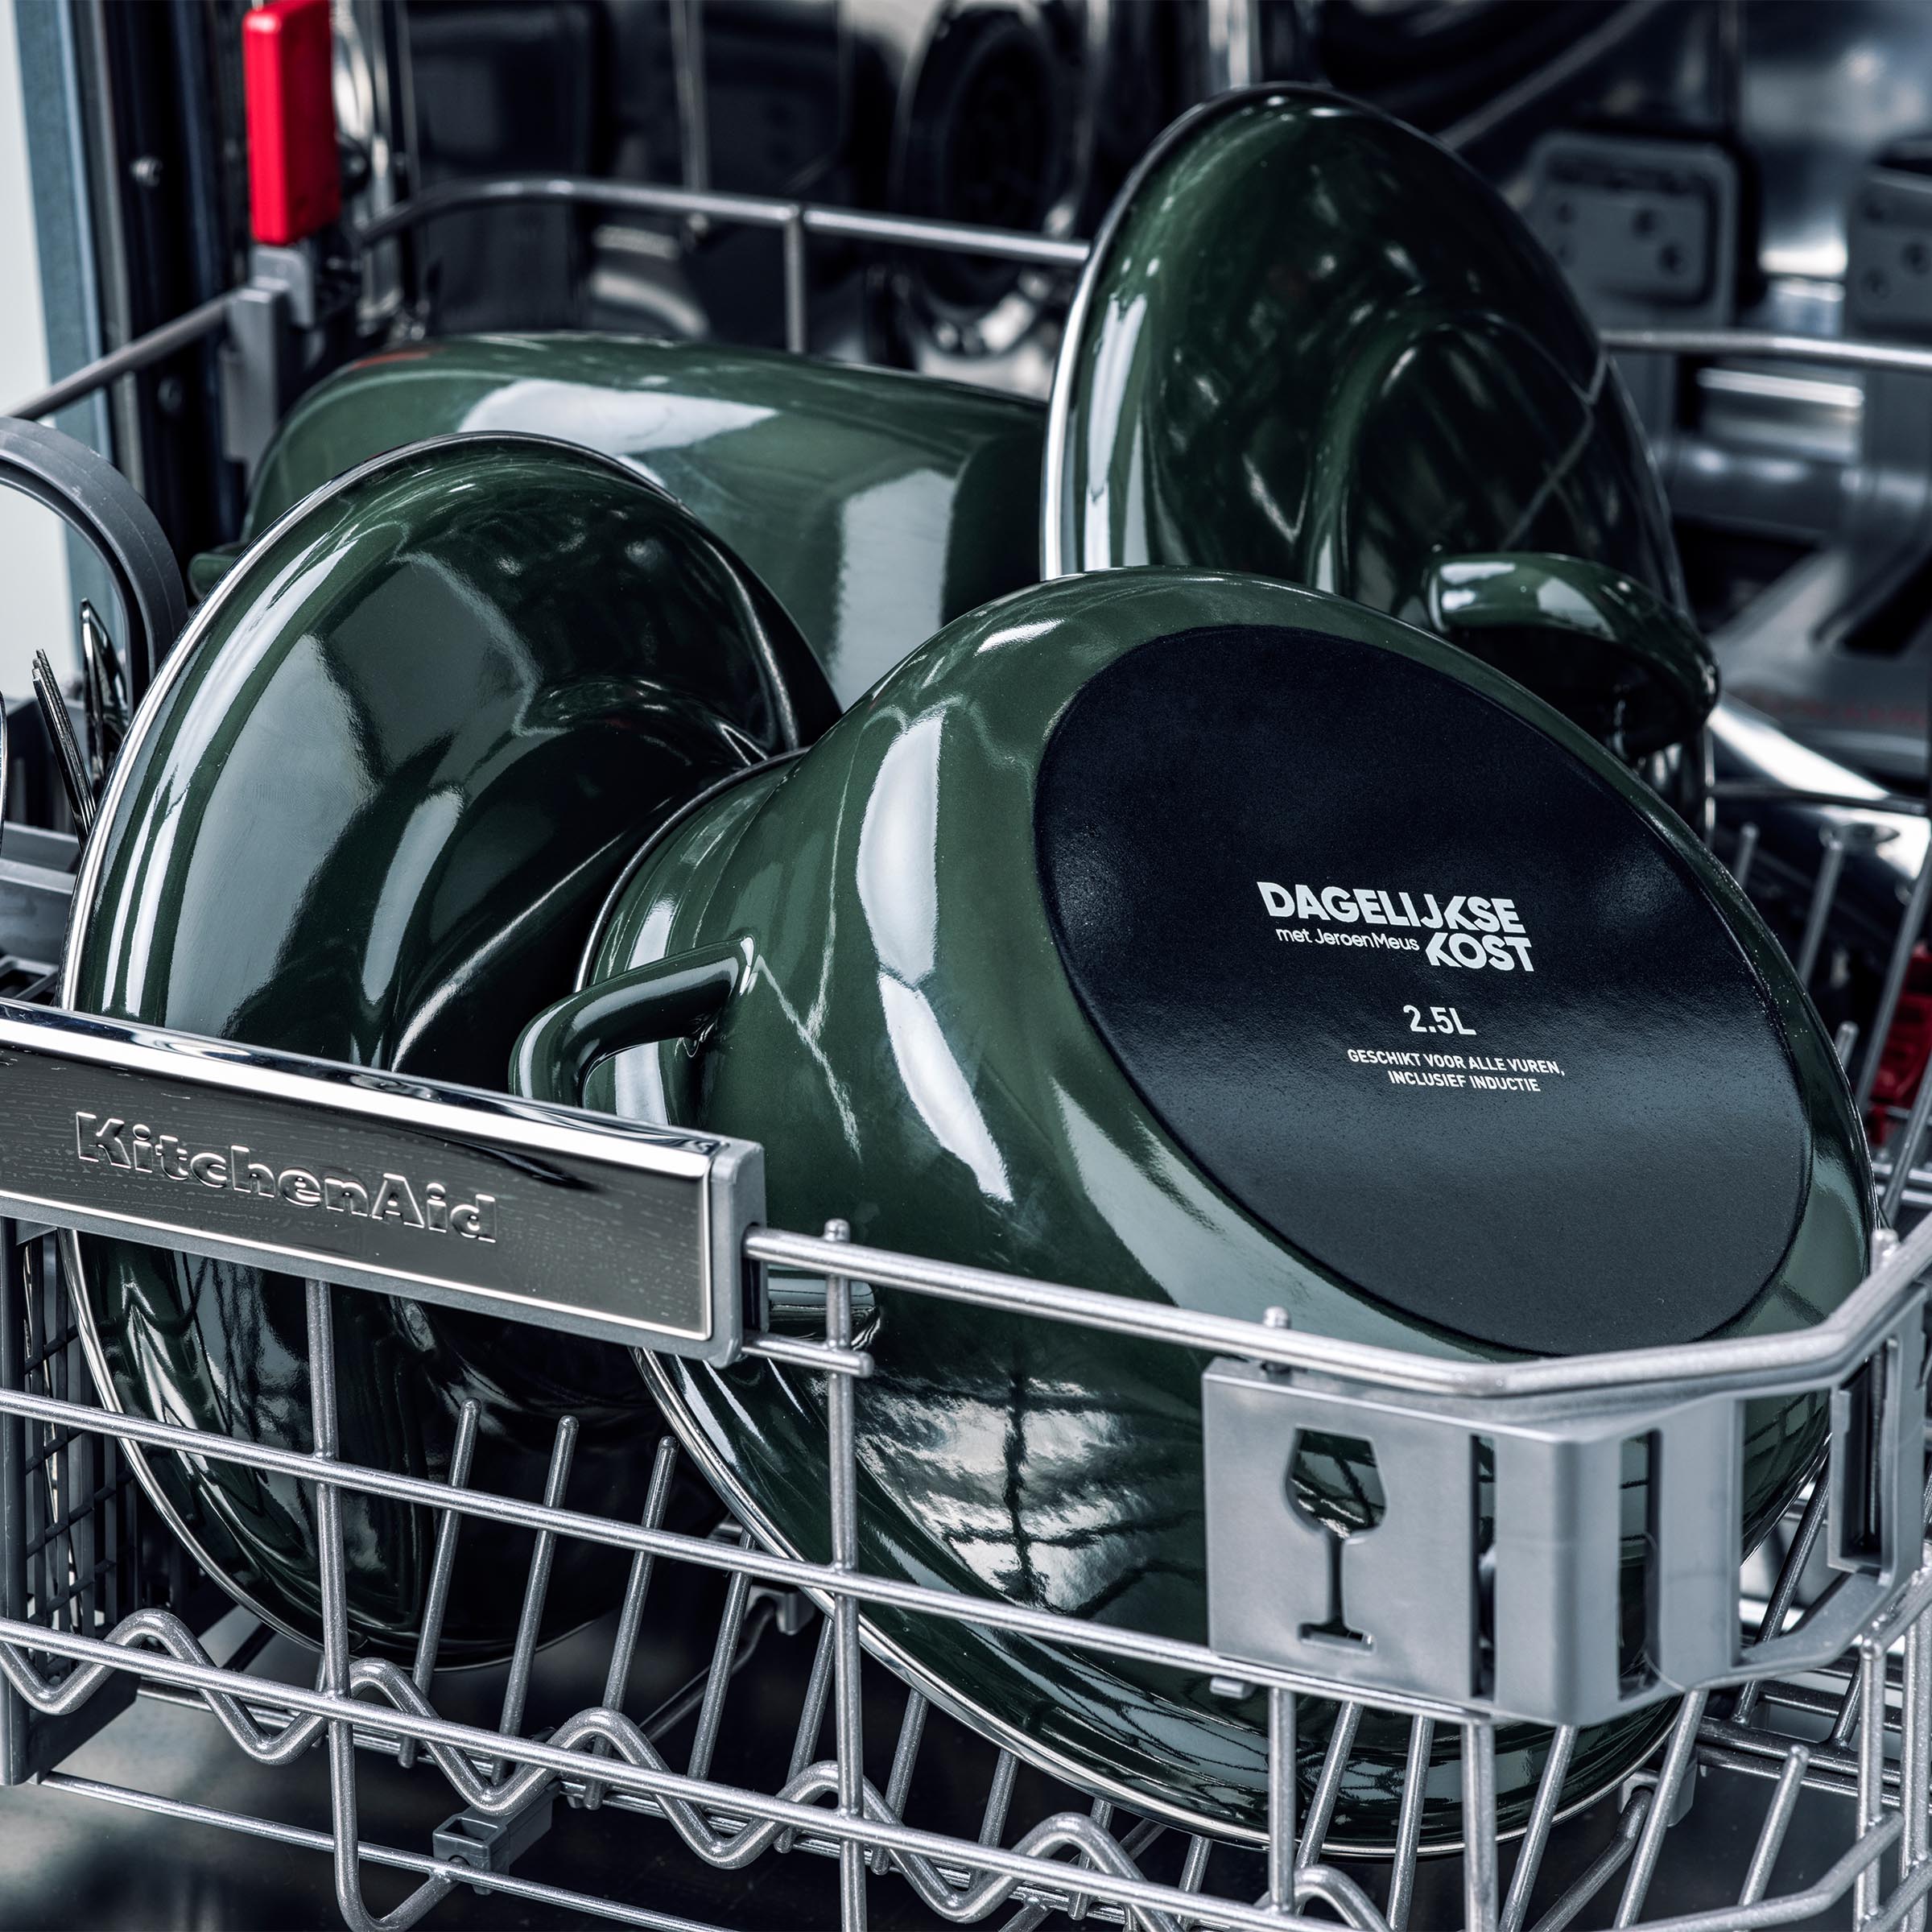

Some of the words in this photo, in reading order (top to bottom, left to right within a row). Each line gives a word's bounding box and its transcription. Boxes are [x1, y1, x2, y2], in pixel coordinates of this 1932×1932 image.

[1256, 881, 1526, 934] DAGELIJKSE
[1275, 928, 1313, 943] met
[1425, 931, 1534, 972] KOST
[1402, 1005, 1477, 1036] 2.5L
[1347, 1048, 1422, 1067] GESCHIKT
[1422, 1053, 1468, 1070] VOOR
[1468, 1055, 1508, 1072] ALLE
[1505, 1058, 1566, 1077] VUREN,
[1387, 1070, 1467, 1088] INCLUSIEF
[1468, 1075, 1542, 1092] INDUCTIE
[75, 1112, 497, 1244] KitchenAid
